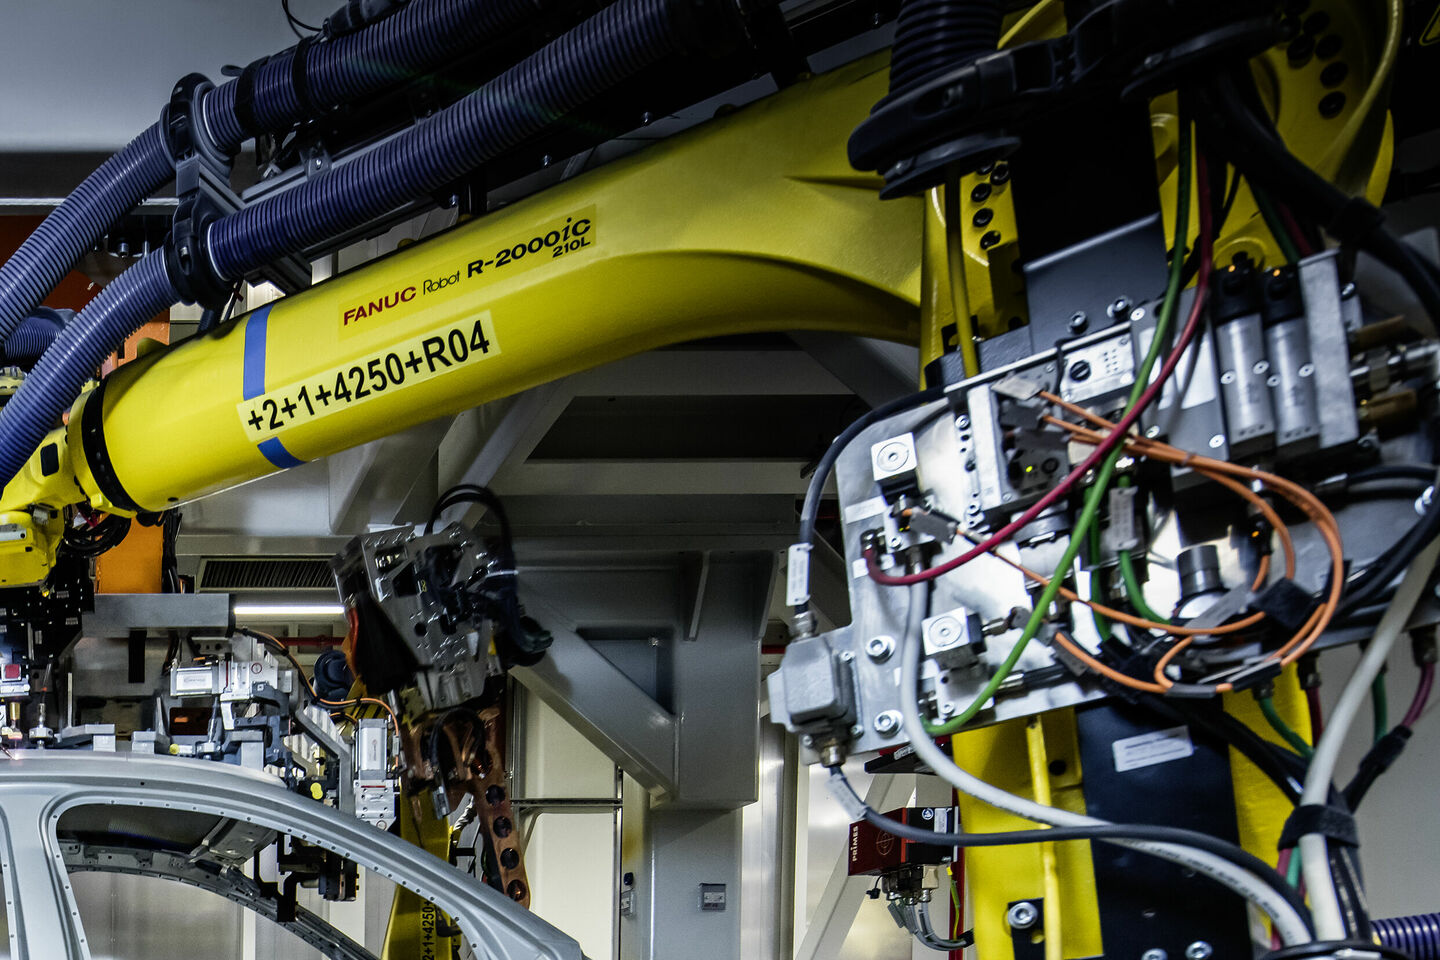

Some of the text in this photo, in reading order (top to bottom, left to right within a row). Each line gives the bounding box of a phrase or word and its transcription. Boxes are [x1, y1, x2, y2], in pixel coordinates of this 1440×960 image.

[343, 216, 592, 327] FANUC Robot R-2000iC
[552, 239, 591, 259] 210L
[247, 319, 491, 432] +2+1+4250+R04
